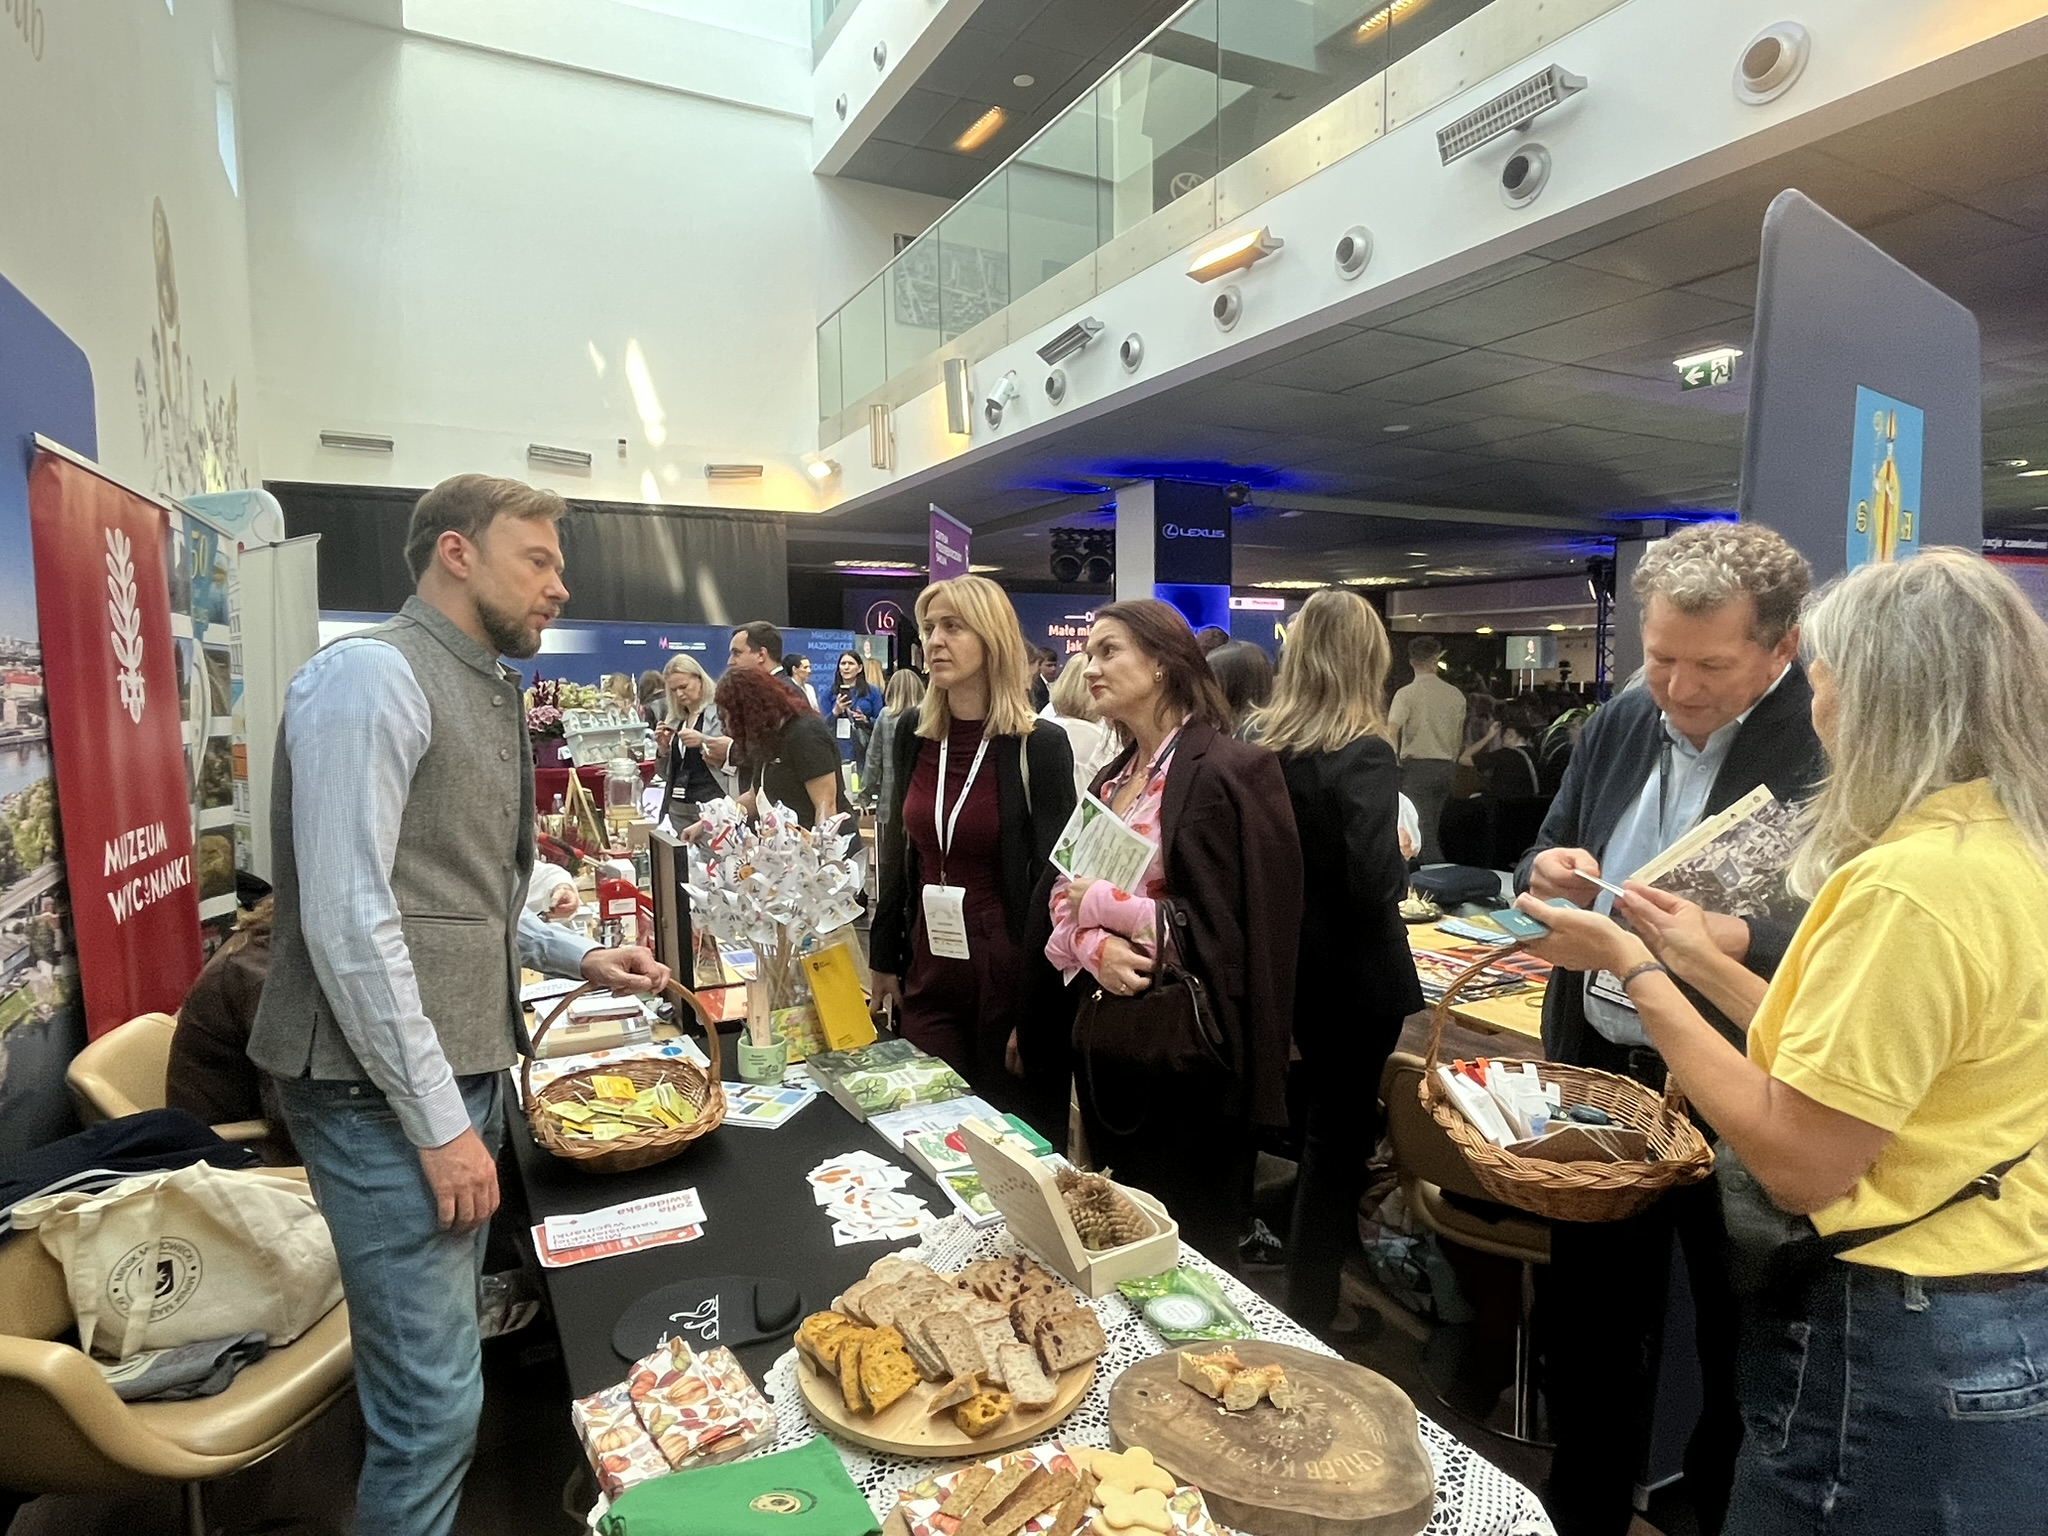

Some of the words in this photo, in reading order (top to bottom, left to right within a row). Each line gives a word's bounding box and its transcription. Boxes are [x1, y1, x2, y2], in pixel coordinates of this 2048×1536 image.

[1179, 527, 1226, 538] LEXUS
[877, 608, 895, 629] 16
[1065, 639, 1083, 655] jak
[103, 820, 168, 877] MUZEUM
